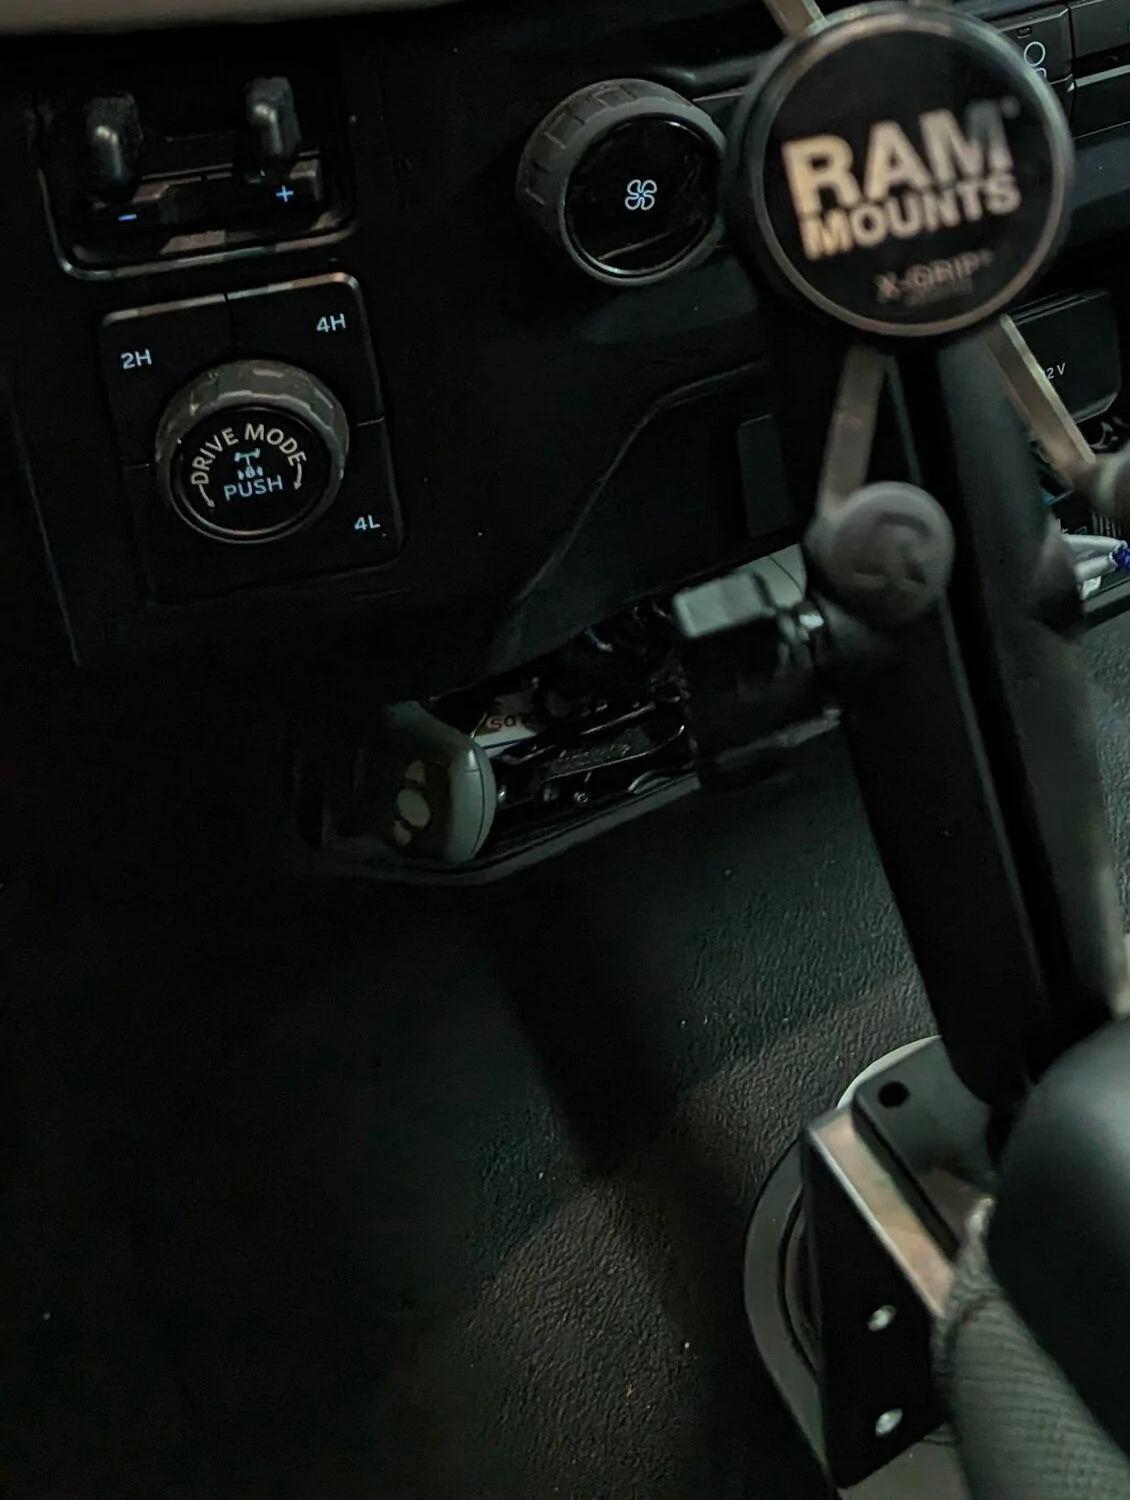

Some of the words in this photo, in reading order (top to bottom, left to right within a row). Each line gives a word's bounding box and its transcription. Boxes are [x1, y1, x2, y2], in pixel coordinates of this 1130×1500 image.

[780, 98, 1014, 219] RAM
[800, 170, 1022, 261] MOUNTS
[315, 312, 347, 333] 4H
[120, 348, 152, 370] 2H
[1055, 361, 1067, 376] V
[190, 427, 239, 485] DRIVE
[245, 422, 307, 467] MODE
[223, 474, 284, 501] PUSH
[353, 513, 381, 531] 4L
